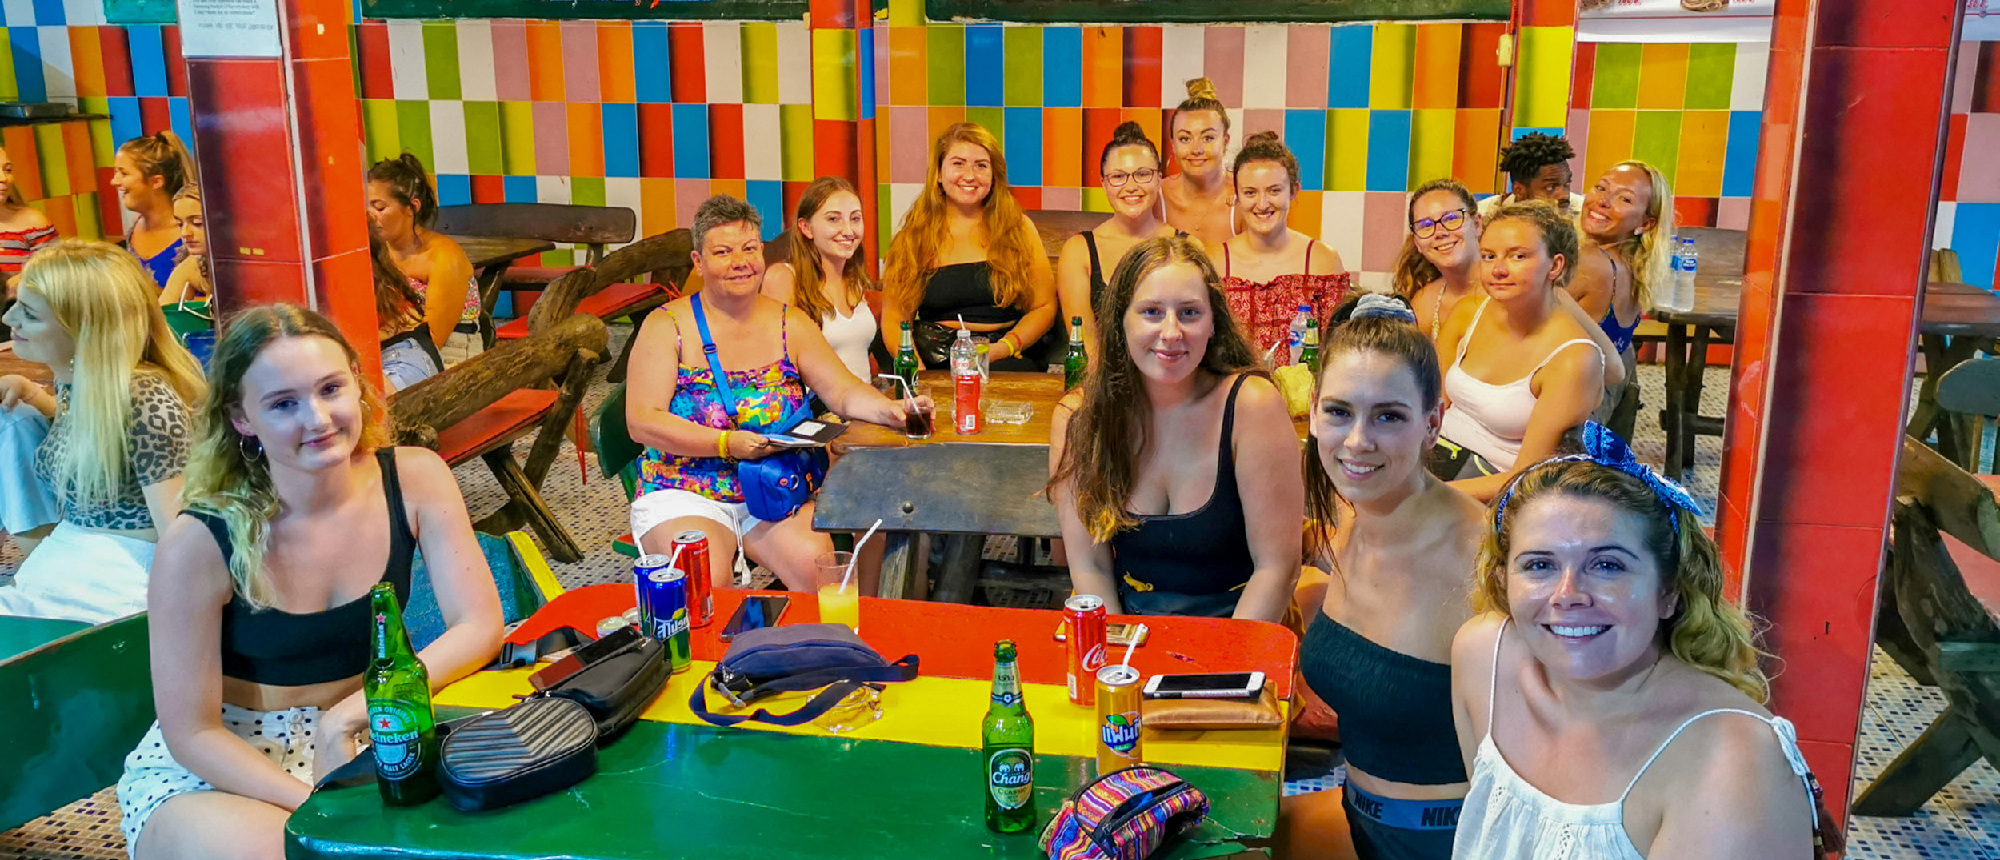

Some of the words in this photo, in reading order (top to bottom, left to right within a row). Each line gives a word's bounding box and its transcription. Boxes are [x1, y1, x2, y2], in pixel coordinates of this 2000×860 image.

[993, 771, 1031, 784] Chang
[1354, 791, 1384, 820] NIKE
[1421, 806, 1462, 827] NIK
